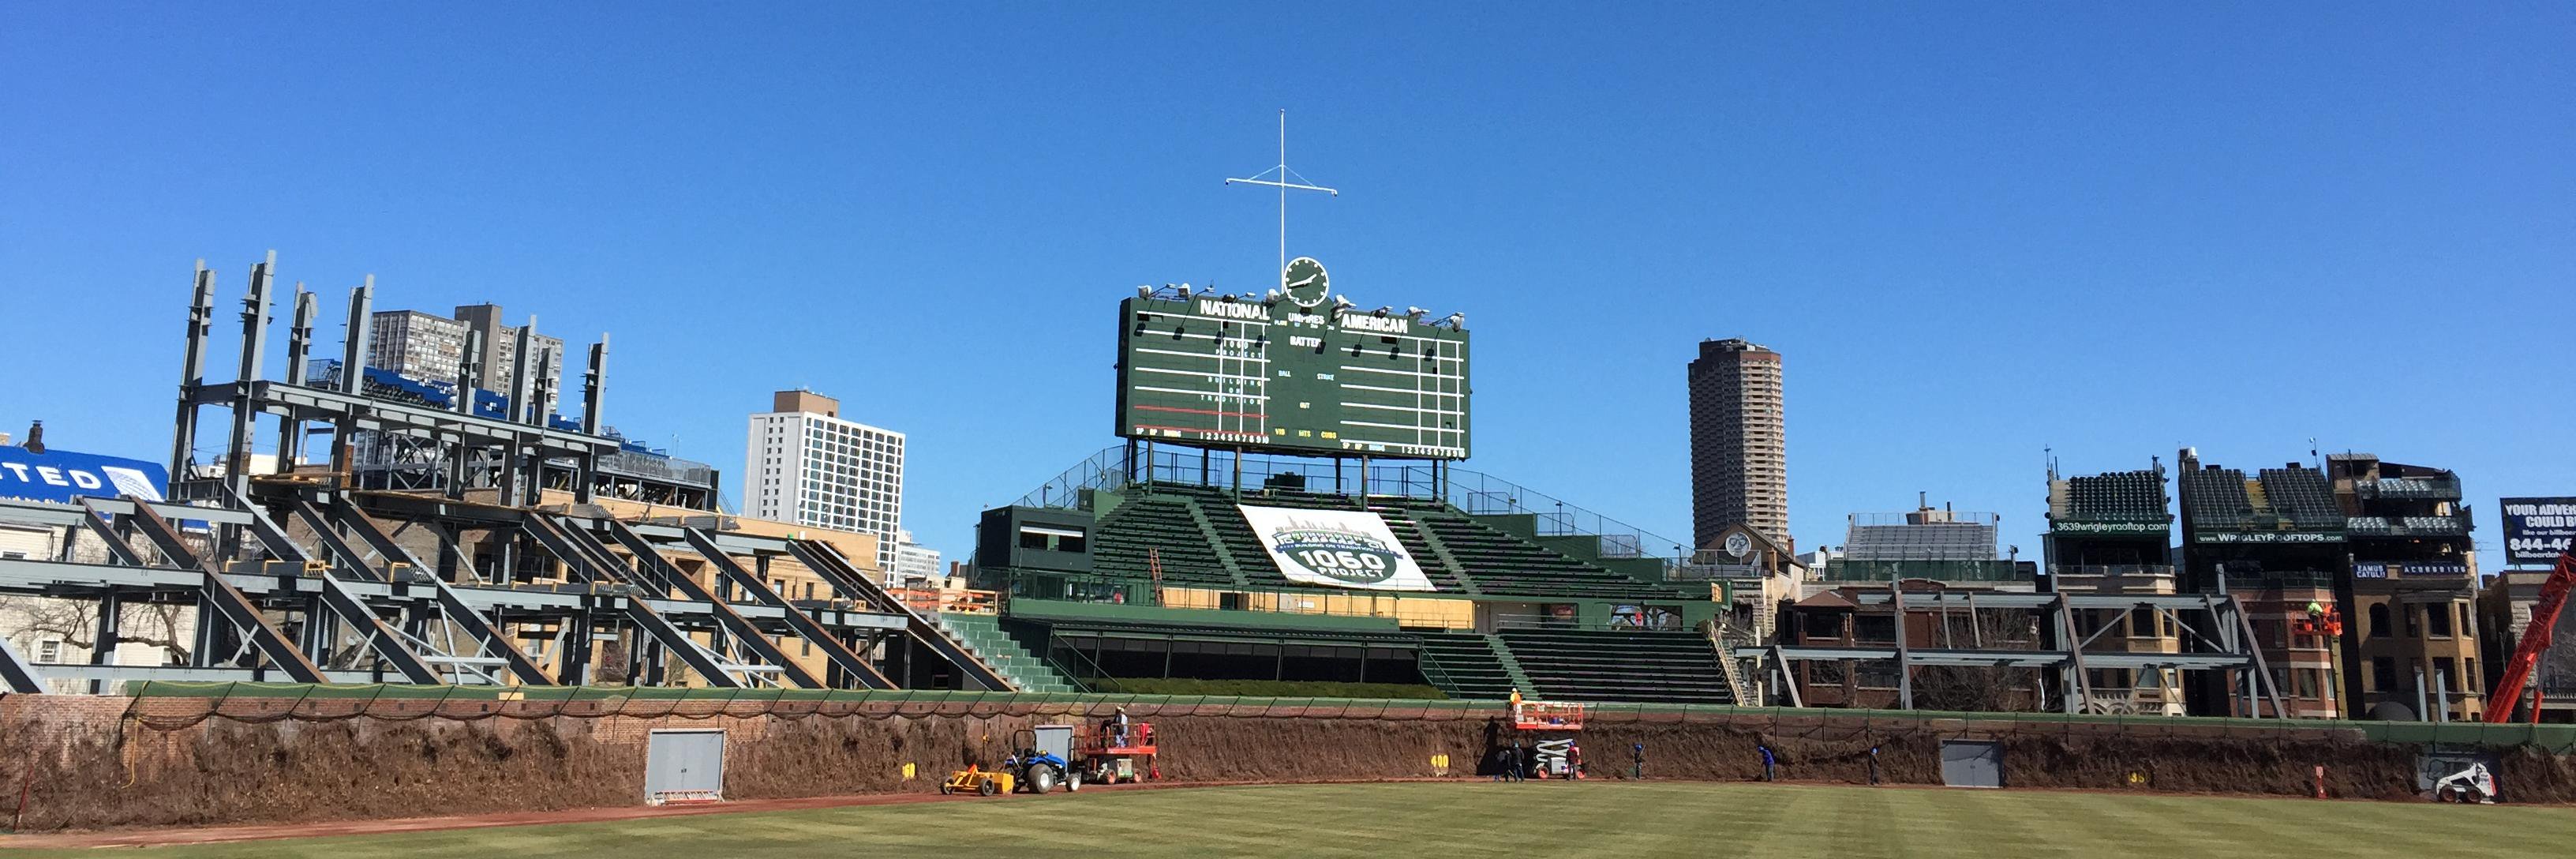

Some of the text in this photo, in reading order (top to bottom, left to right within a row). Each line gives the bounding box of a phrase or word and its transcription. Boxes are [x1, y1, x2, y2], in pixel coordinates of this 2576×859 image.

[1200, 300, 1270, 320] NATIONAL
[1288, 313, 1324, 324] UMPIRES
[1341, 313, 1408, 333] AMERICAN
[0, 462, 101, 490] TED
[2505, 504, 2537, 516] YOUR
[2525, 516, 2576, 527] COULD B
[1298, 550, 1386, 570] 1060
[1317, 566, 1384, 577] PROJECT
[1431, 755, 1449, 767] 400
